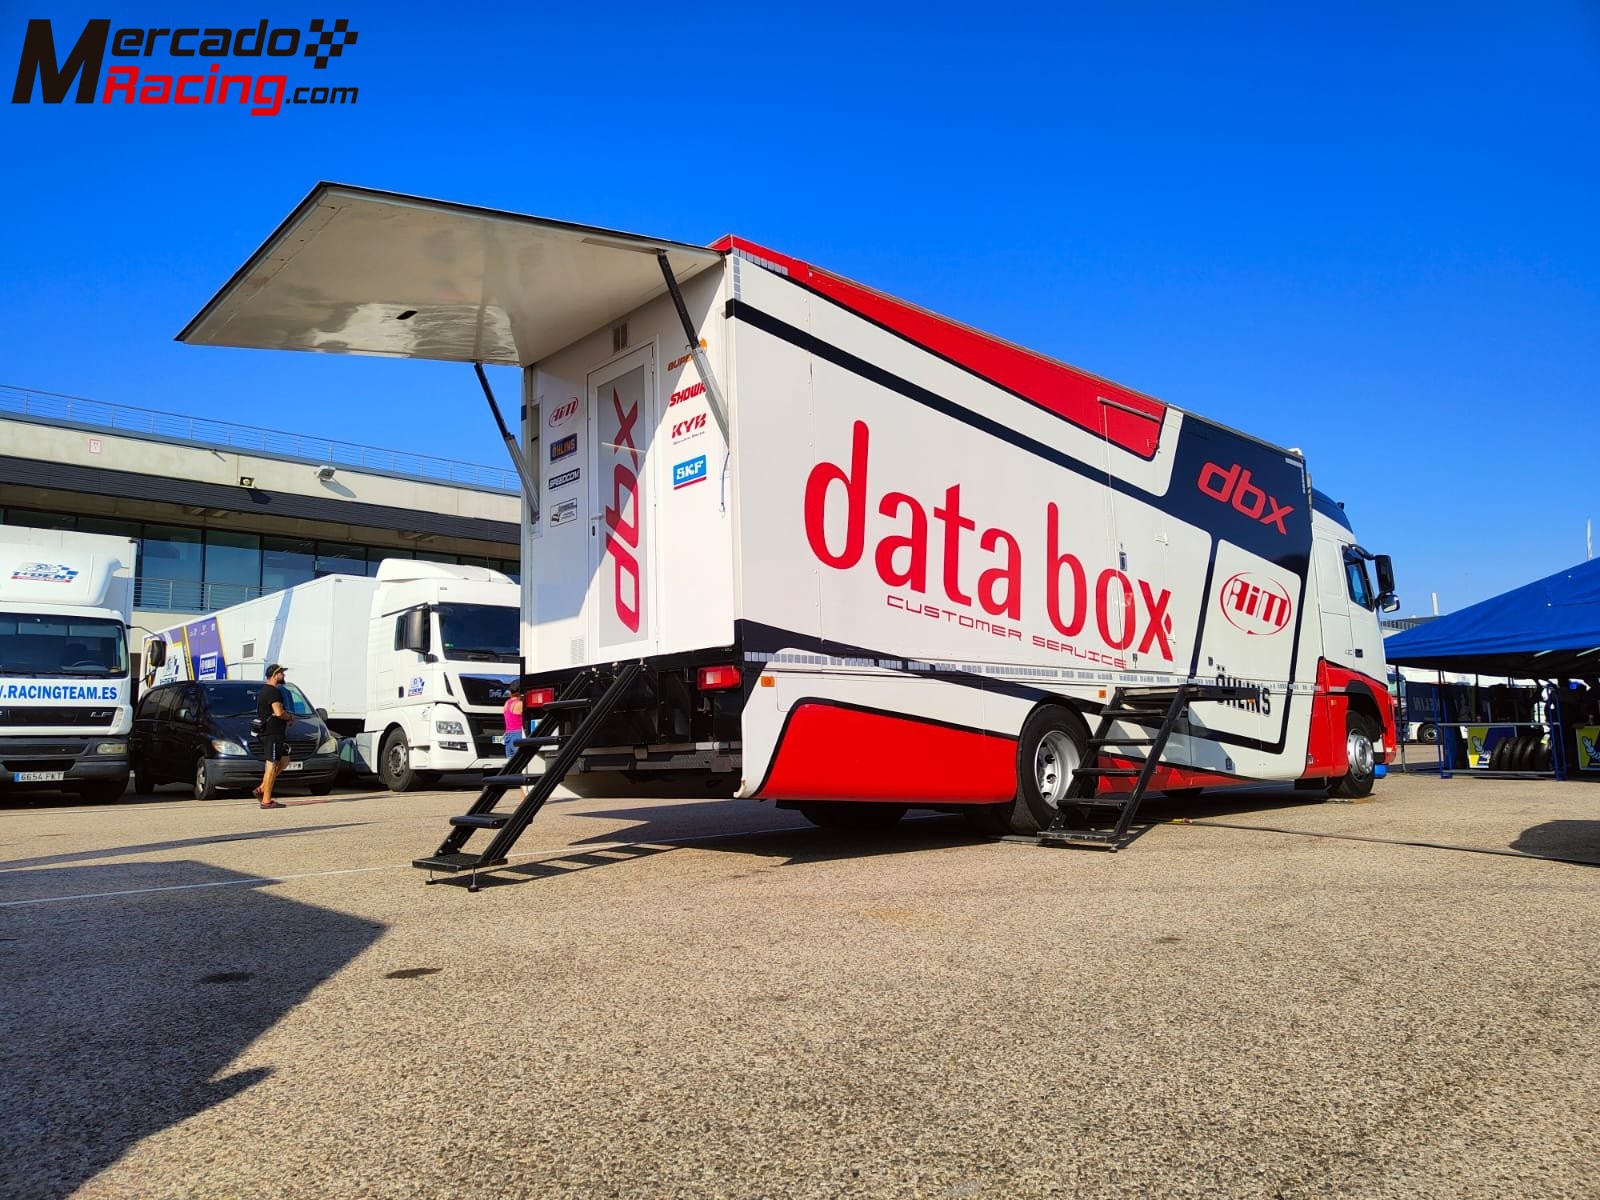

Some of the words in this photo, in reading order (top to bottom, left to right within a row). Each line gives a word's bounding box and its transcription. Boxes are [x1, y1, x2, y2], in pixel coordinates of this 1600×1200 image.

[672, 413, 707, 438] KYB
[676, 460, 704, 480] SKF
[1197, 462, 1295, 535] dbx
[606, 386, 640, 634] dbx
[804, 420, 1022, 621] data
[1047, 502, 1174, 662] box
[887, 594, 1022, 642] CUSTOMER
